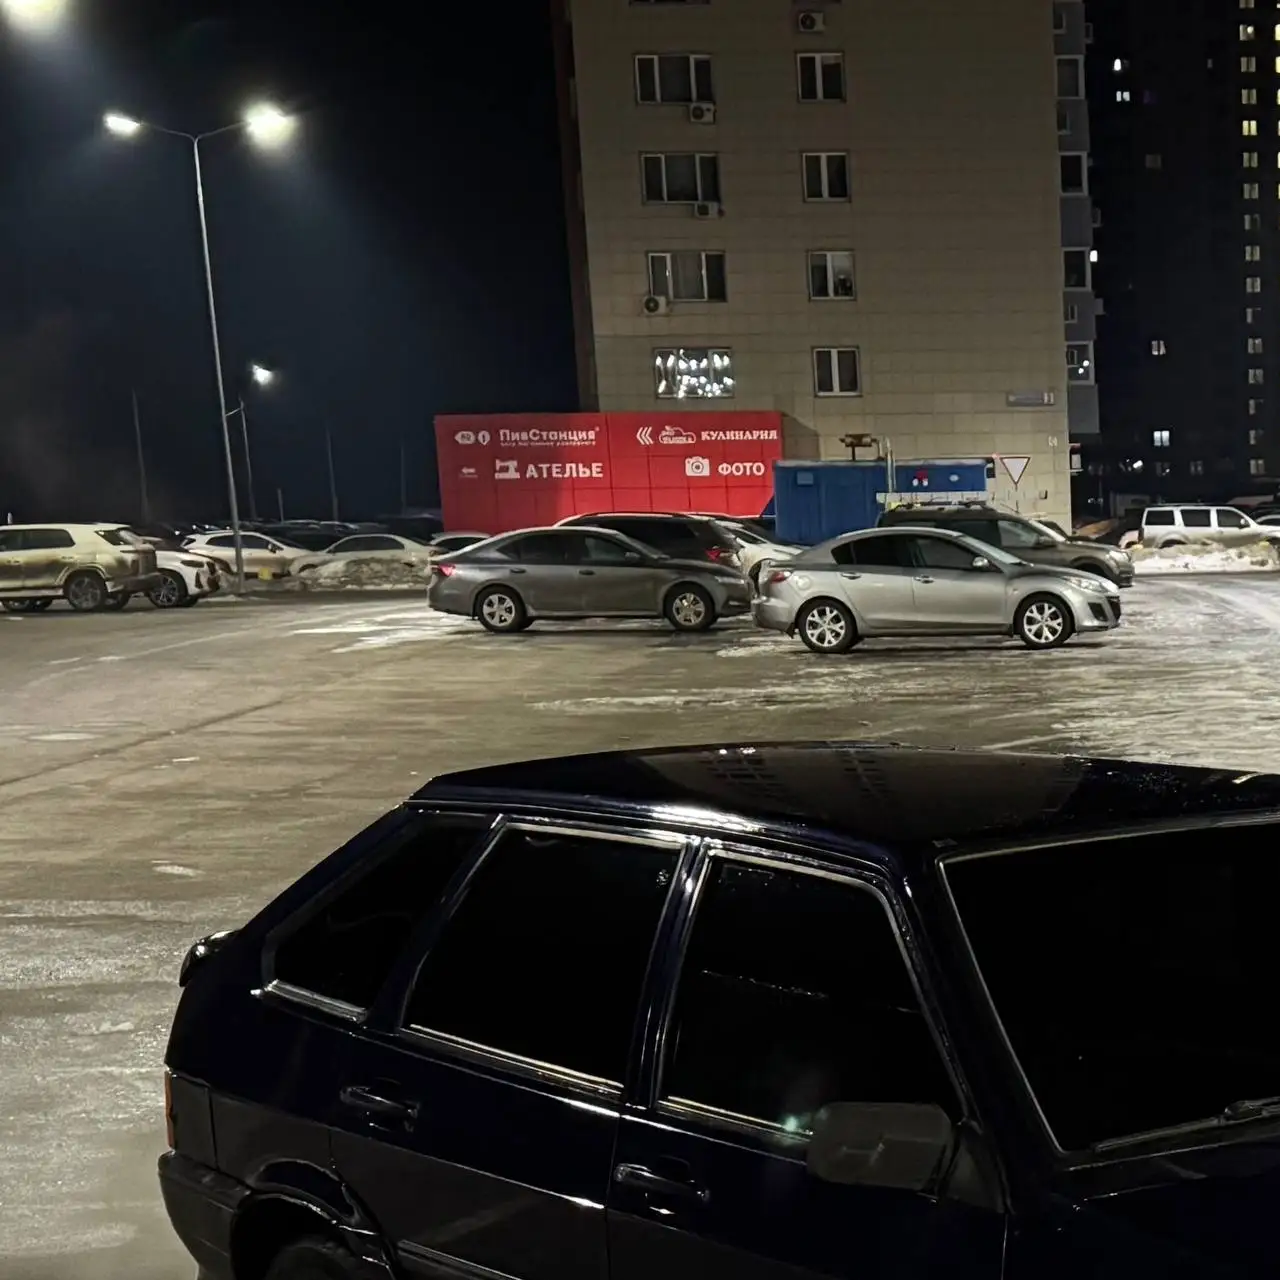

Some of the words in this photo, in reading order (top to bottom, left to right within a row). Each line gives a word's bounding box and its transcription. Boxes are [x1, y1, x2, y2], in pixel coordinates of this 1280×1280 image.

[499, 429, 596, 442] ПивСтанция
[701, 430, 777, 440] КУЛИНАРИЯ
[526, 463, 604, 479] АТЕЛЬЕ
[718, 462, 765, 476] ФОТО
